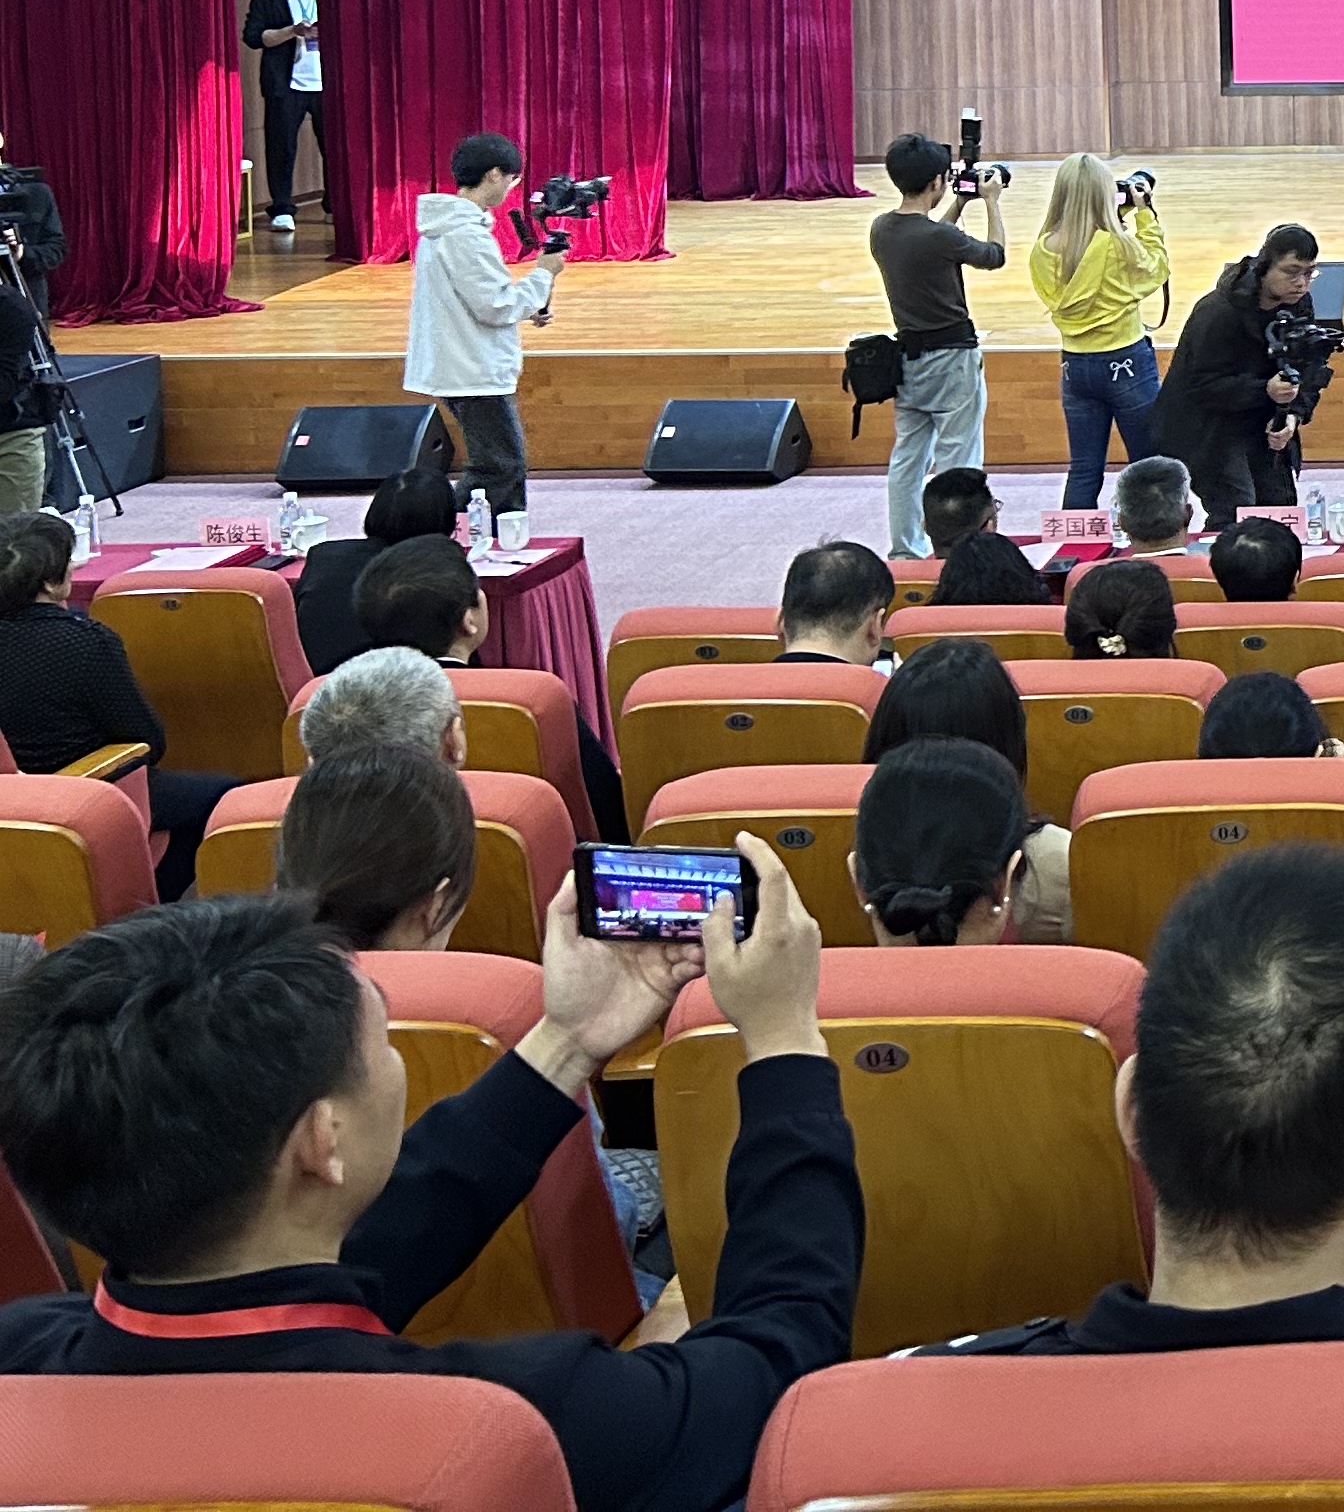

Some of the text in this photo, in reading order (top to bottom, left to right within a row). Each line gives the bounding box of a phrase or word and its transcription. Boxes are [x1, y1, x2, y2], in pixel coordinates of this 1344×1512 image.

[206, 523, 265, 544] 陈俊生
[1044, 516, 1109, 538] 李国章
[731, 715, 748, 727] 02
[1071, 709, 1088, 721] 03
[784, 830, 806, 845] 03
[1218, 826, 1240, 840] 04
[867, 1048, 895, 1066] 04
